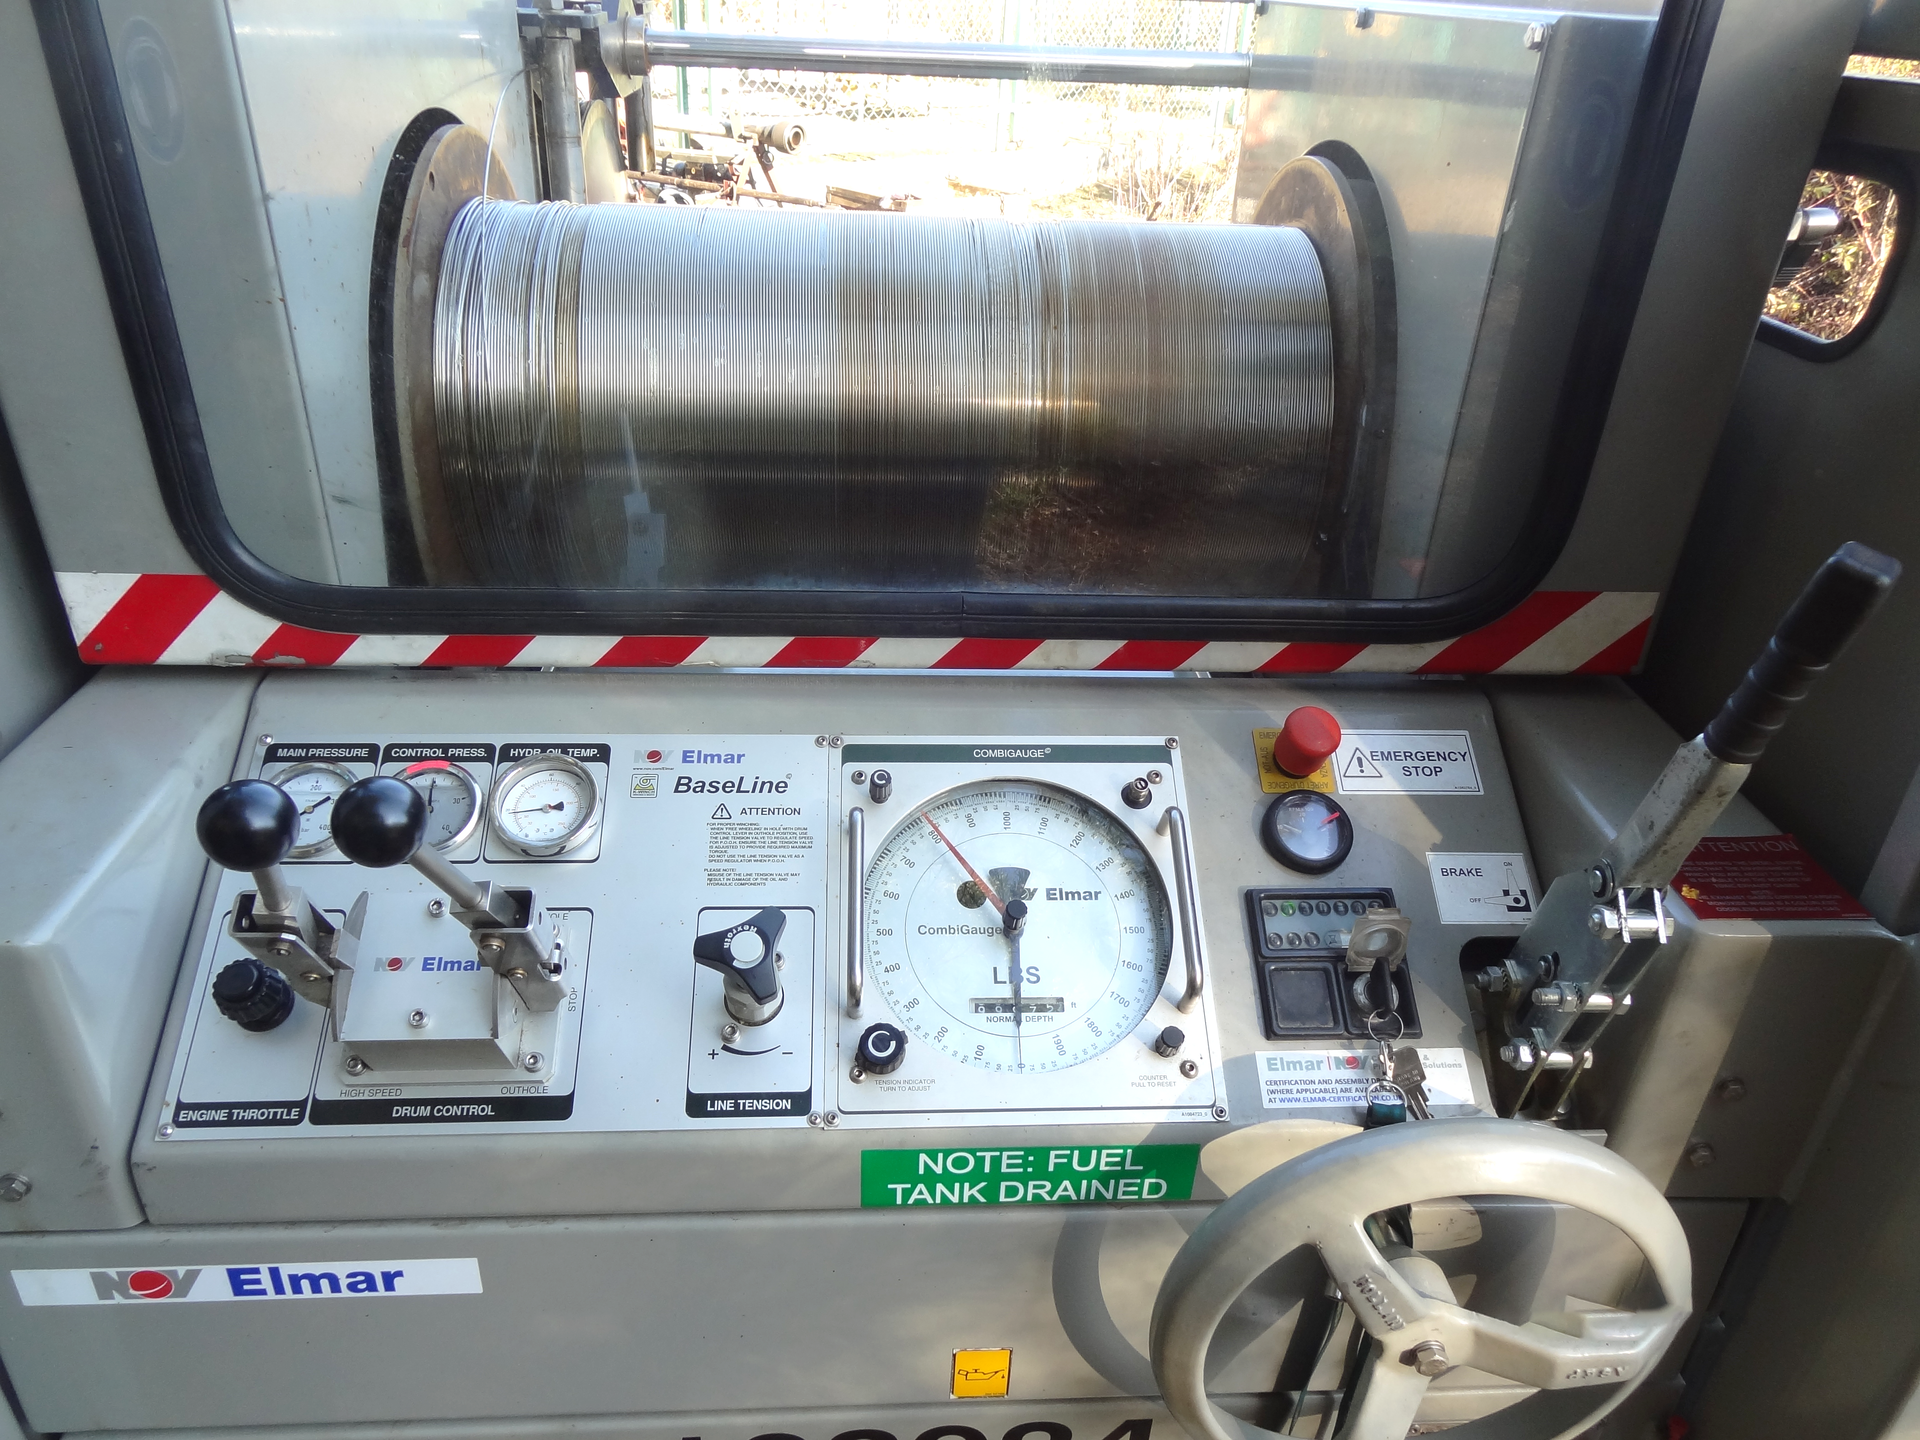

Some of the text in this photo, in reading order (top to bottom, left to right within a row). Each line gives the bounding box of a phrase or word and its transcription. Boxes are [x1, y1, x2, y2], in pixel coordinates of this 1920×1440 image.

[277, 748, 370, 757] MAIN PRESSURE
[391, 748, 487, 757] CONTROL PRESS.
[567, 748, 600, 757] TEMP.
[681, 749, 745, 764] Elmar
[1370, 751, 1467, 762] EMERGENCY
[1402, 766, 1443, 777] STOP
[452, 797, 461, 805] 30
[740, 807, 801, 816] ATTENTION
[964, 813, 976, 828] 900
[1003, 811, 1011, 830] 1000
[1037, 817, 1049, 836] 1100
[927, 829, 942, 844] 800
[1070, 831, 1086, 849] 1200
[900, 855, 915, 868] 700
[1095, 856, 1115, 872] 1300
[1440, 868, 1483, 877] BRAKE
[883, 890, 900, 901] 600
[1045, 887, 1102, 901] Elmar
[1114, 889, 1135, 901] 1400
[876, 928, 893, 936] 500
[917, 924, 1002, 937] CombiGauge
[1123, 926, 1145, 934] 1500
[883, 962, 901, 974] 400
[1121, 960, 1143, 972] 1600
[568, 987, 577, 1012] STOP
[903, 997, 920, 1013] 300
[1109, 990, 1130, 1008] 1700
[986, 1015, 1054, 1023] NORMA DEPTH
[1084, 1017, 1103, 1038] 1800
[933, 1026, 949, 1044] 200
[1052, 1034, 1067, 1056] 1900
[973, 1044, 985, 1062] 100
[1266, 1057, 1324, 1072] Elmar
[1422, 1061, 1462, 1069] Solutions
[1265, 1078, 1315, 1087] CERTIFICATION
[1317, 1078, 1333, 1086] AND
[1335, 1077, 1370, 1085] ASSEMBLY
[339, 1088, 403, 1098] HIGH SPEED
[500, 1086, 549, 1095] OUTHOLE
[1266, 1087, 1294, 1096] (WHERE
[1296, 1086, 1338, 1095] APPLICABLE)
[1339, 1085, 1353, 1093] ARE
[707, 1099, 791, 1111] LINE TENSION
[1278, 1095, 1403, 1103] WWW.ELMAR-CERTIFICATON.CO.UK
[179, 1108, 300, 1122] ENGINE THROTTLE
[392, 1104, 495, 1117] DRUM CONTROL
[918, 1149, 1144, 1175] NOTE: FUEL
[887, 1178, 1168, 1205] TANK DRAINED
[225, 1267, 404, 1297] Elmar
